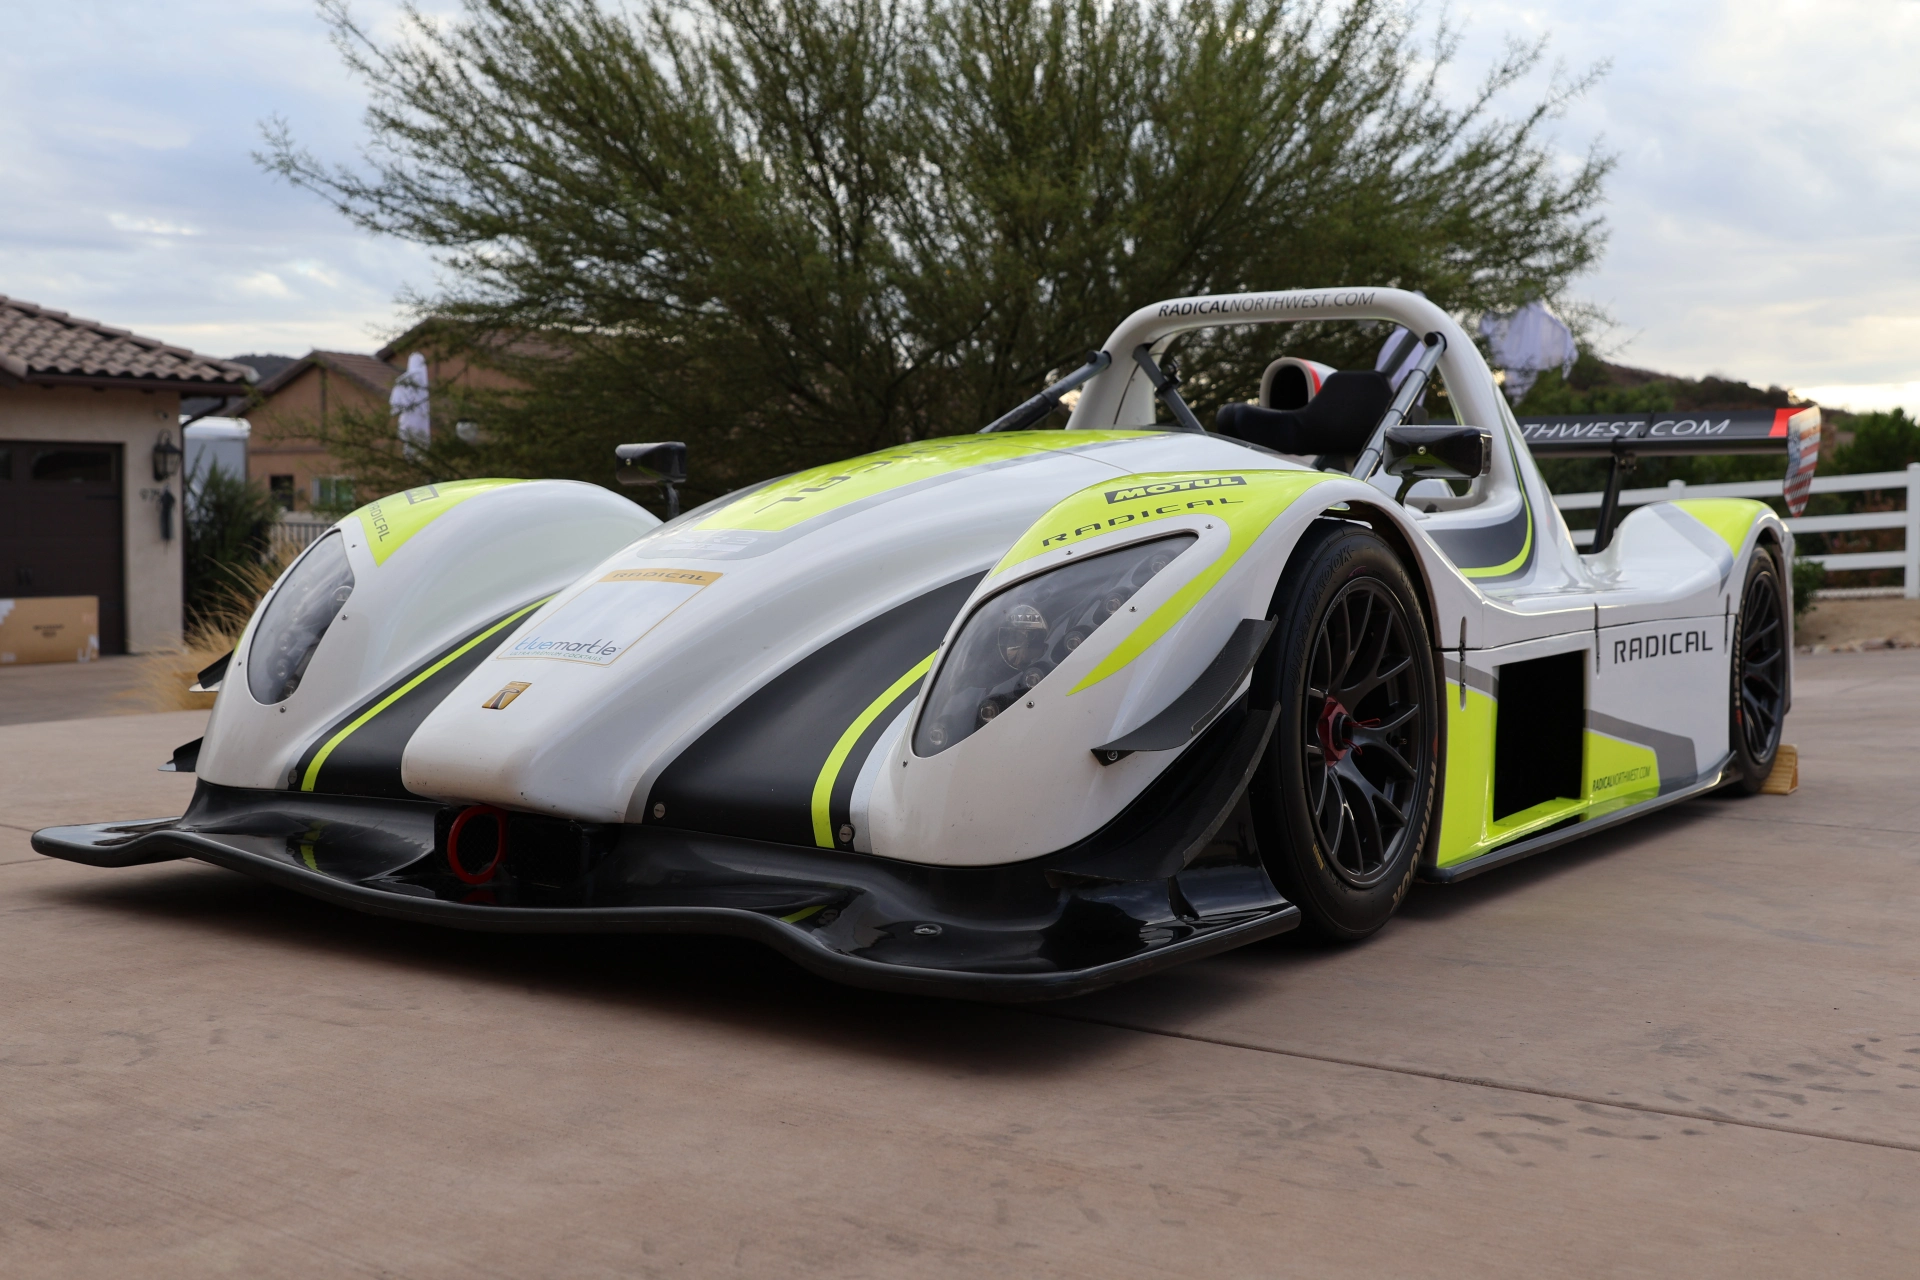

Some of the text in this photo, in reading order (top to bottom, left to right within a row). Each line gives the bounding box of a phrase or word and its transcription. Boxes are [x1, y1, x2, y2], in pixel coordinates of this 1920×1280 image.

[1158, 292, 1376, 317] RADICALNORTHWEST.COM
[1112, 476, 1241, 502] MOTUL
[1042, 497, 1245, 548] RADICAL
[612, 572, 707, 582] RADICAL
[1613, 630, 1713, 664] RADICAL
